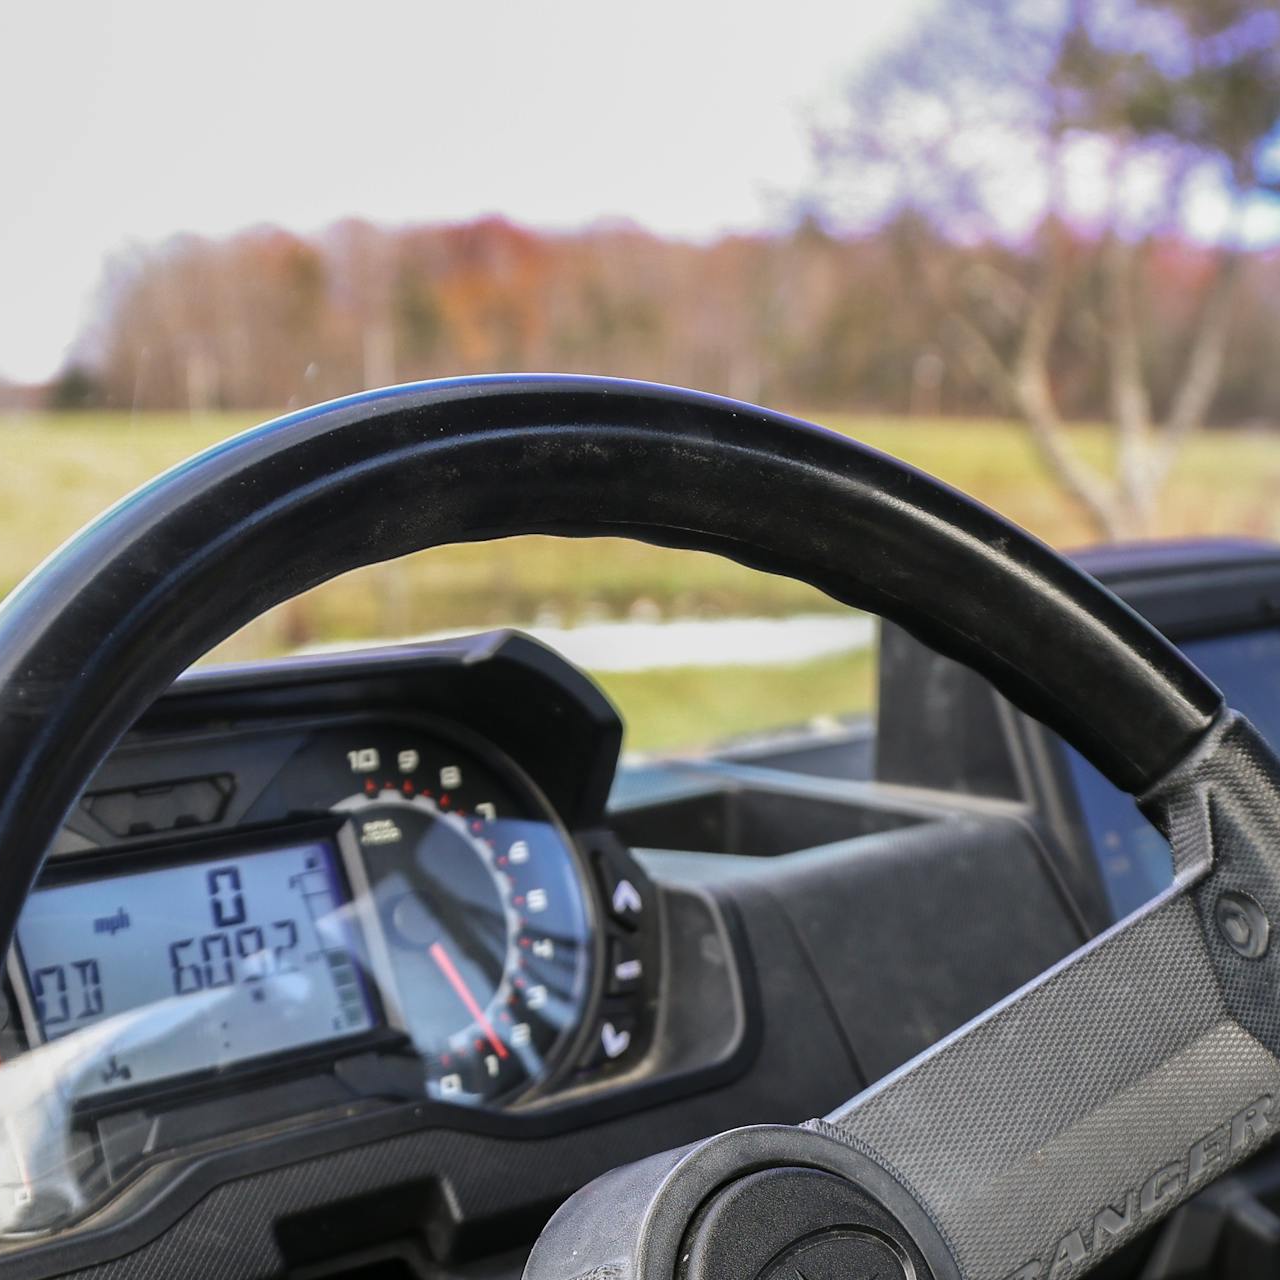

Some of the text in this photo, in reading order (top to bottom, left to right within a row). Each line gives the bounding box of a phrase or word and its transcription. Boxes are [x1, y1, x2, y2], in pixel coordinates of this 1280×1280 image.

[347, 748, 379, 772] 10
[398, 750, 419, 772] 9
[439, 766, 461, 789] 8
[475, 802, 496, 822] 7
[508, 841, 529, 865] 6
[207, 866, 247, 928] 0
[526, 888, 547, 913] 5
[94, 906, 131, 936] mph
[532, 938, 554, 960] 4
[526, 985, 548, 1010] 3
[485, 1054, 499, 1077] 1
[440, 1073, 462, 1096] 0
